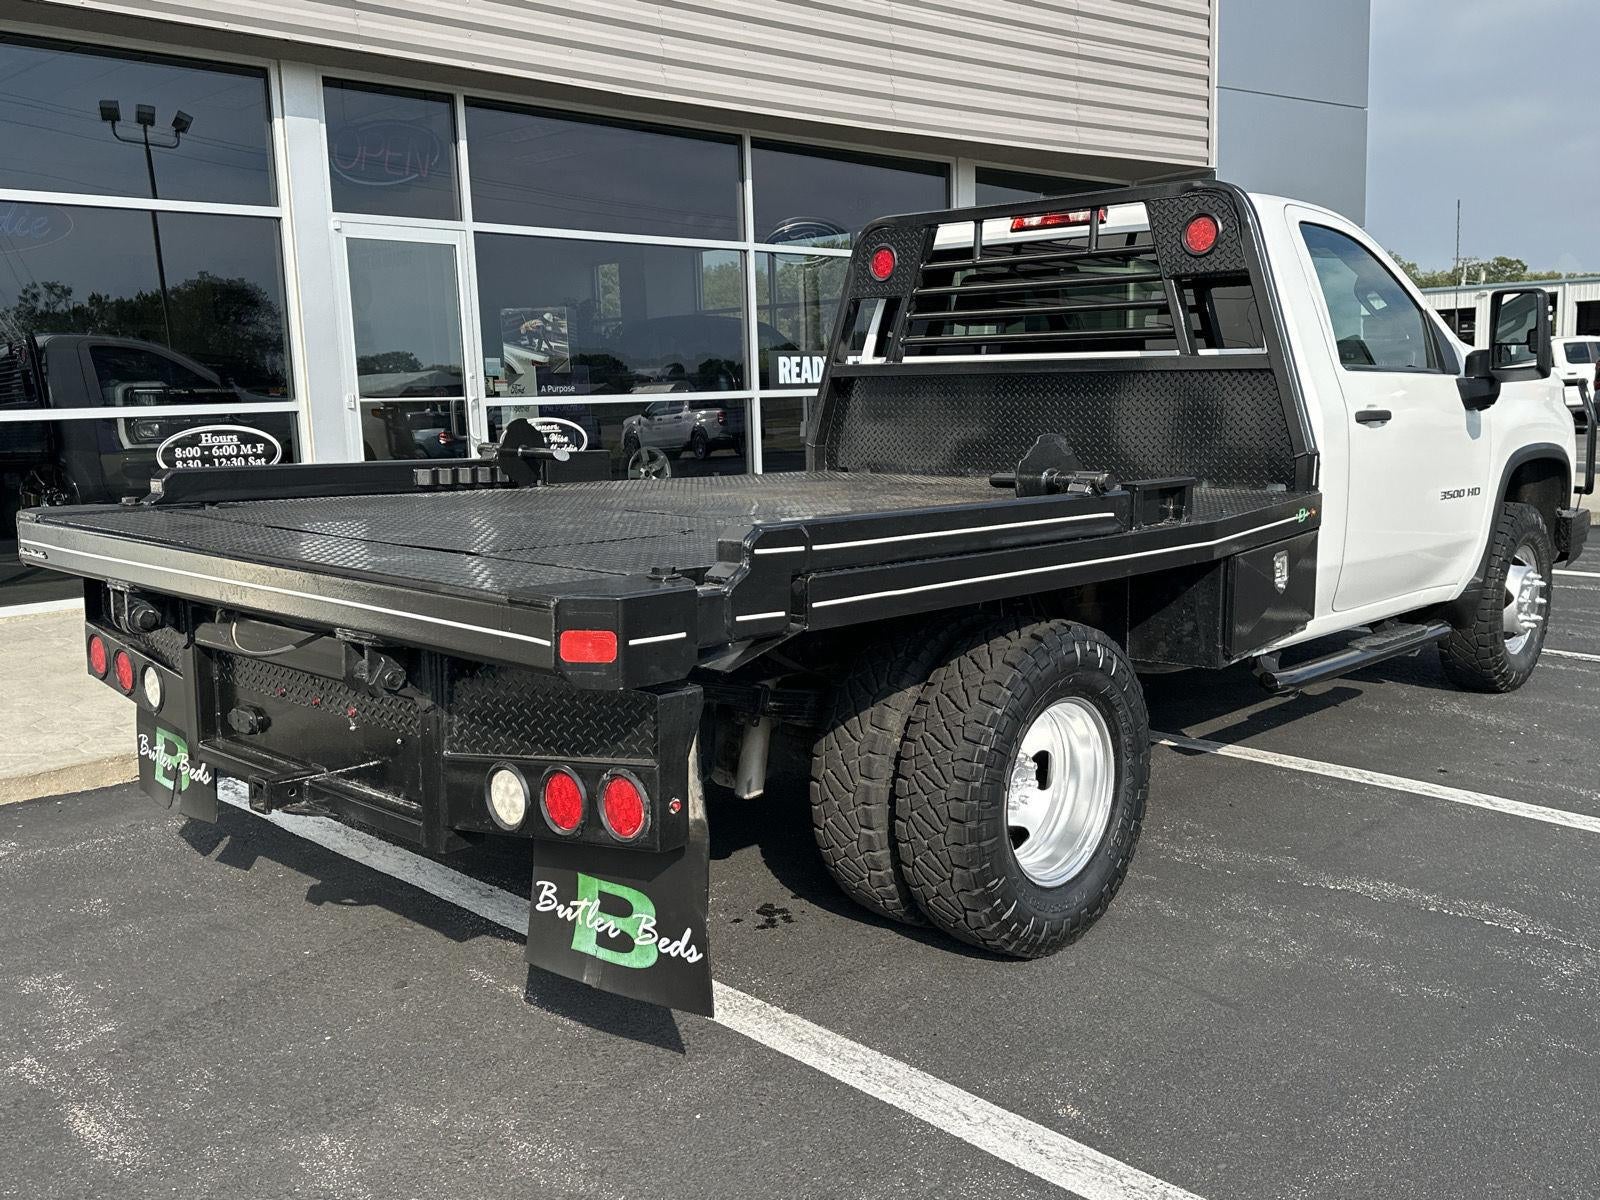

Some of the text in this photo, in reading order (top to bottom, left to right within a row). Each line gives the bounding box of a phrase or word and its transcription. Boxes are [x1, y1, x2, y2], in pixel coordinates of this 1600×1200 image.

[333, 131, 431, 178] OPEN
[777, 355, 828, 384] READ
[541, 384, 576, 394] A Purpose
[200, 433, 239, 444] Hours
[549, 433, 569, 443] Wise
[175, 447, 201, 459] 8:00
[212, 445, 238, 456] 6:00
[240, 443, 265, 455] M-F
[175, 460, 202, 469] 8:30
[213, 457, 246, 467] 12:30
[248, 456, 267, 466] Sat
[1440, 487, 1481, 501] 3500 HD
[138, 733, 212, 785] Butler Beds
[535, 880, 703, 964] Butler Beds
